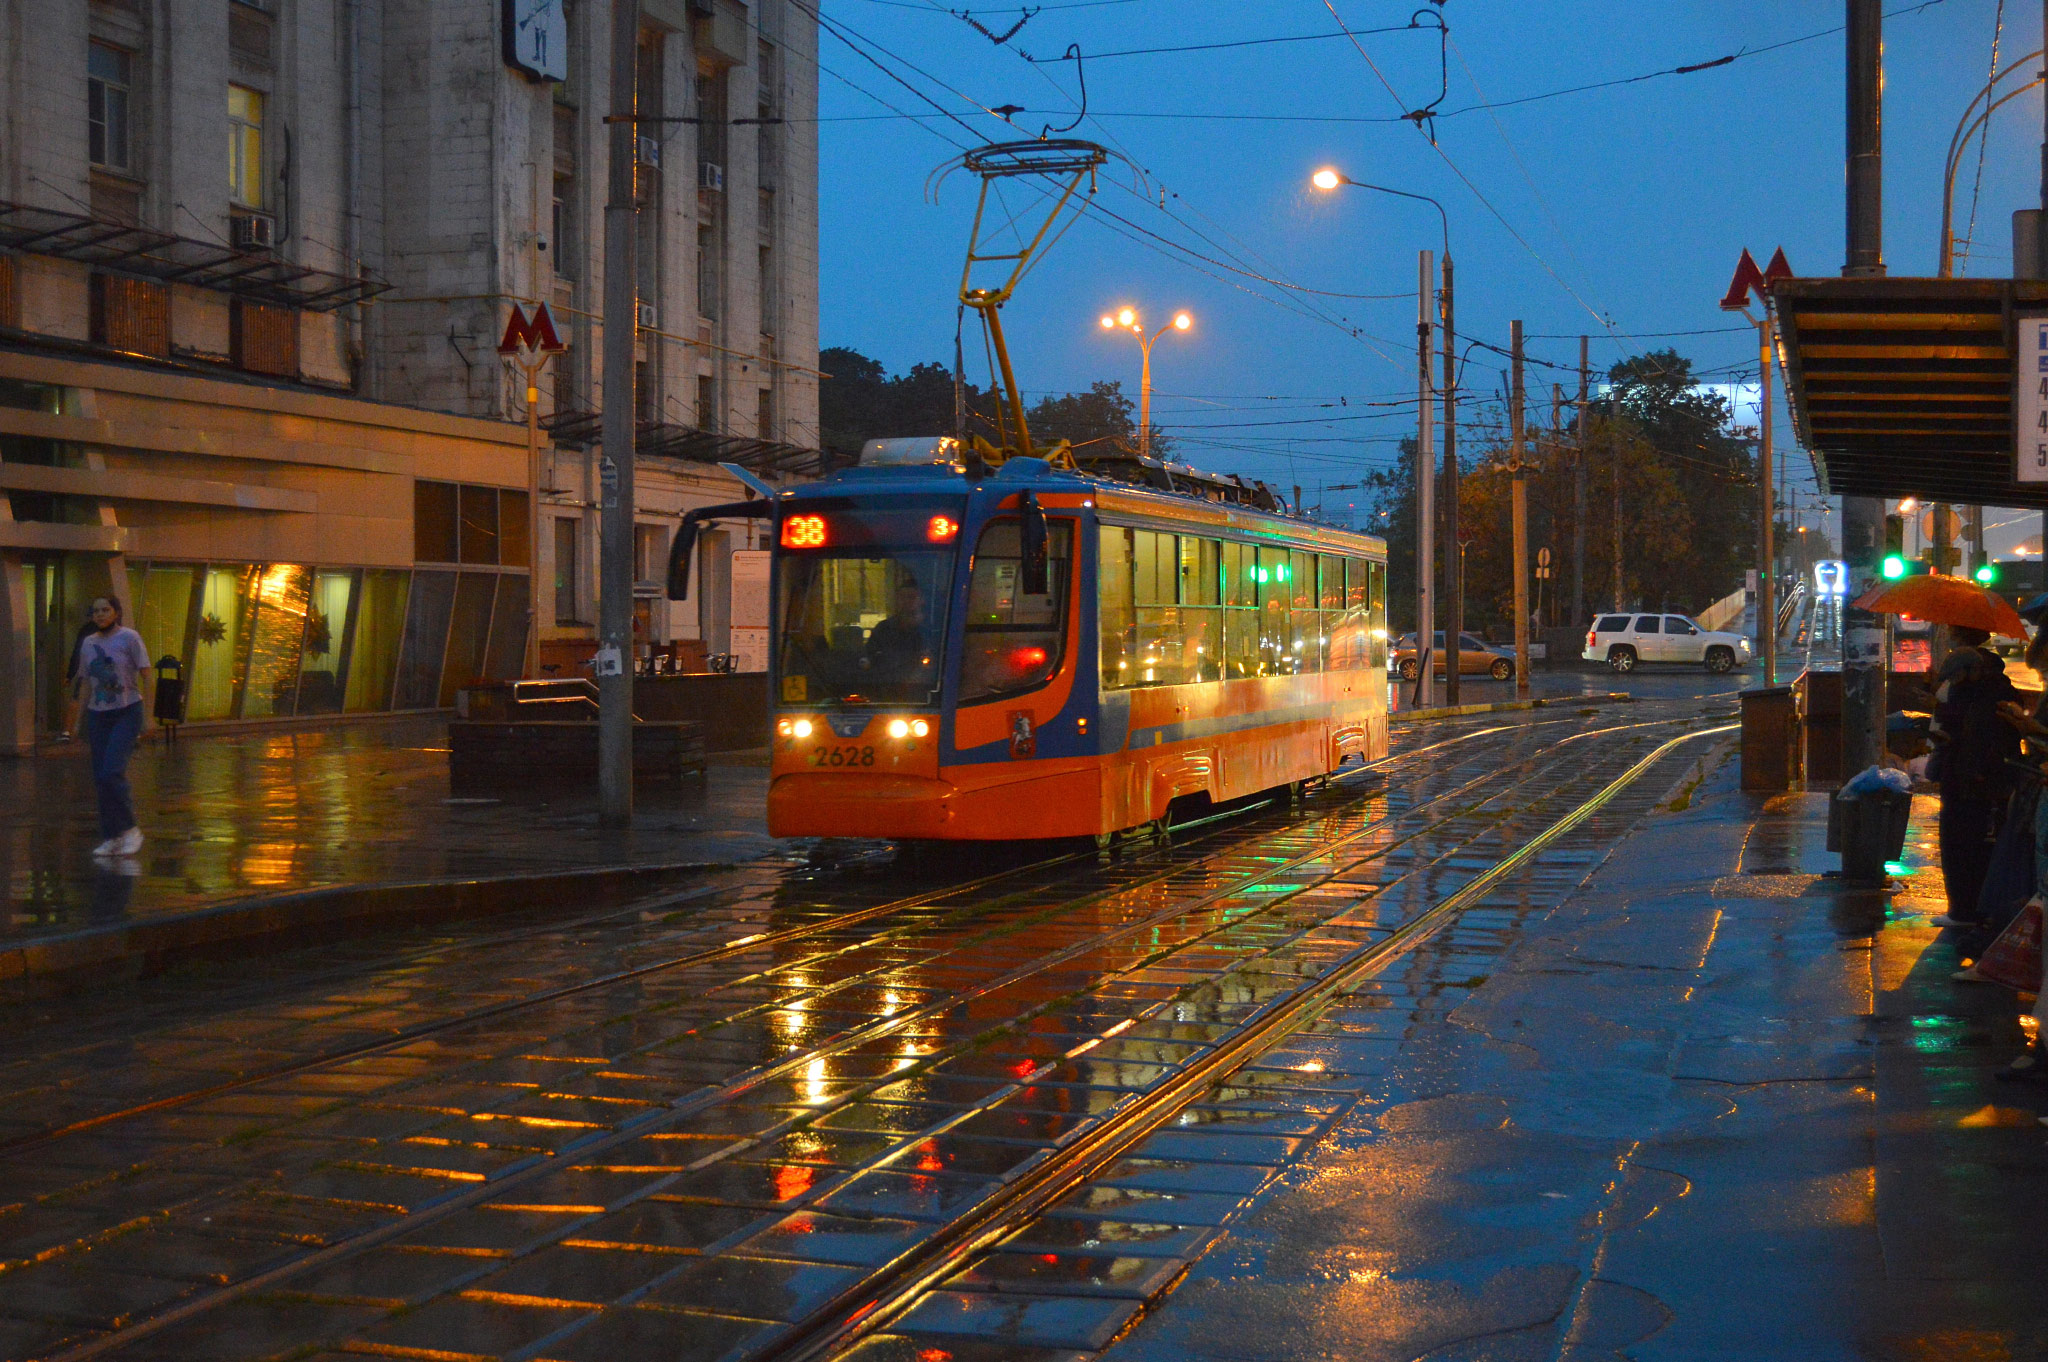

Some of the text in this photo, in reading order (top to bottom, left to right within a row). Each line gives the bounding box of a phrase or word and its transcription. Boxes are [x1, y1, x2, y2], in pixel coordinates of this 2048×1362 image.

[498, 300, 564, 353] М
[790, 516, 825, 545] 38
[814, 745, 875, 767] 2628
